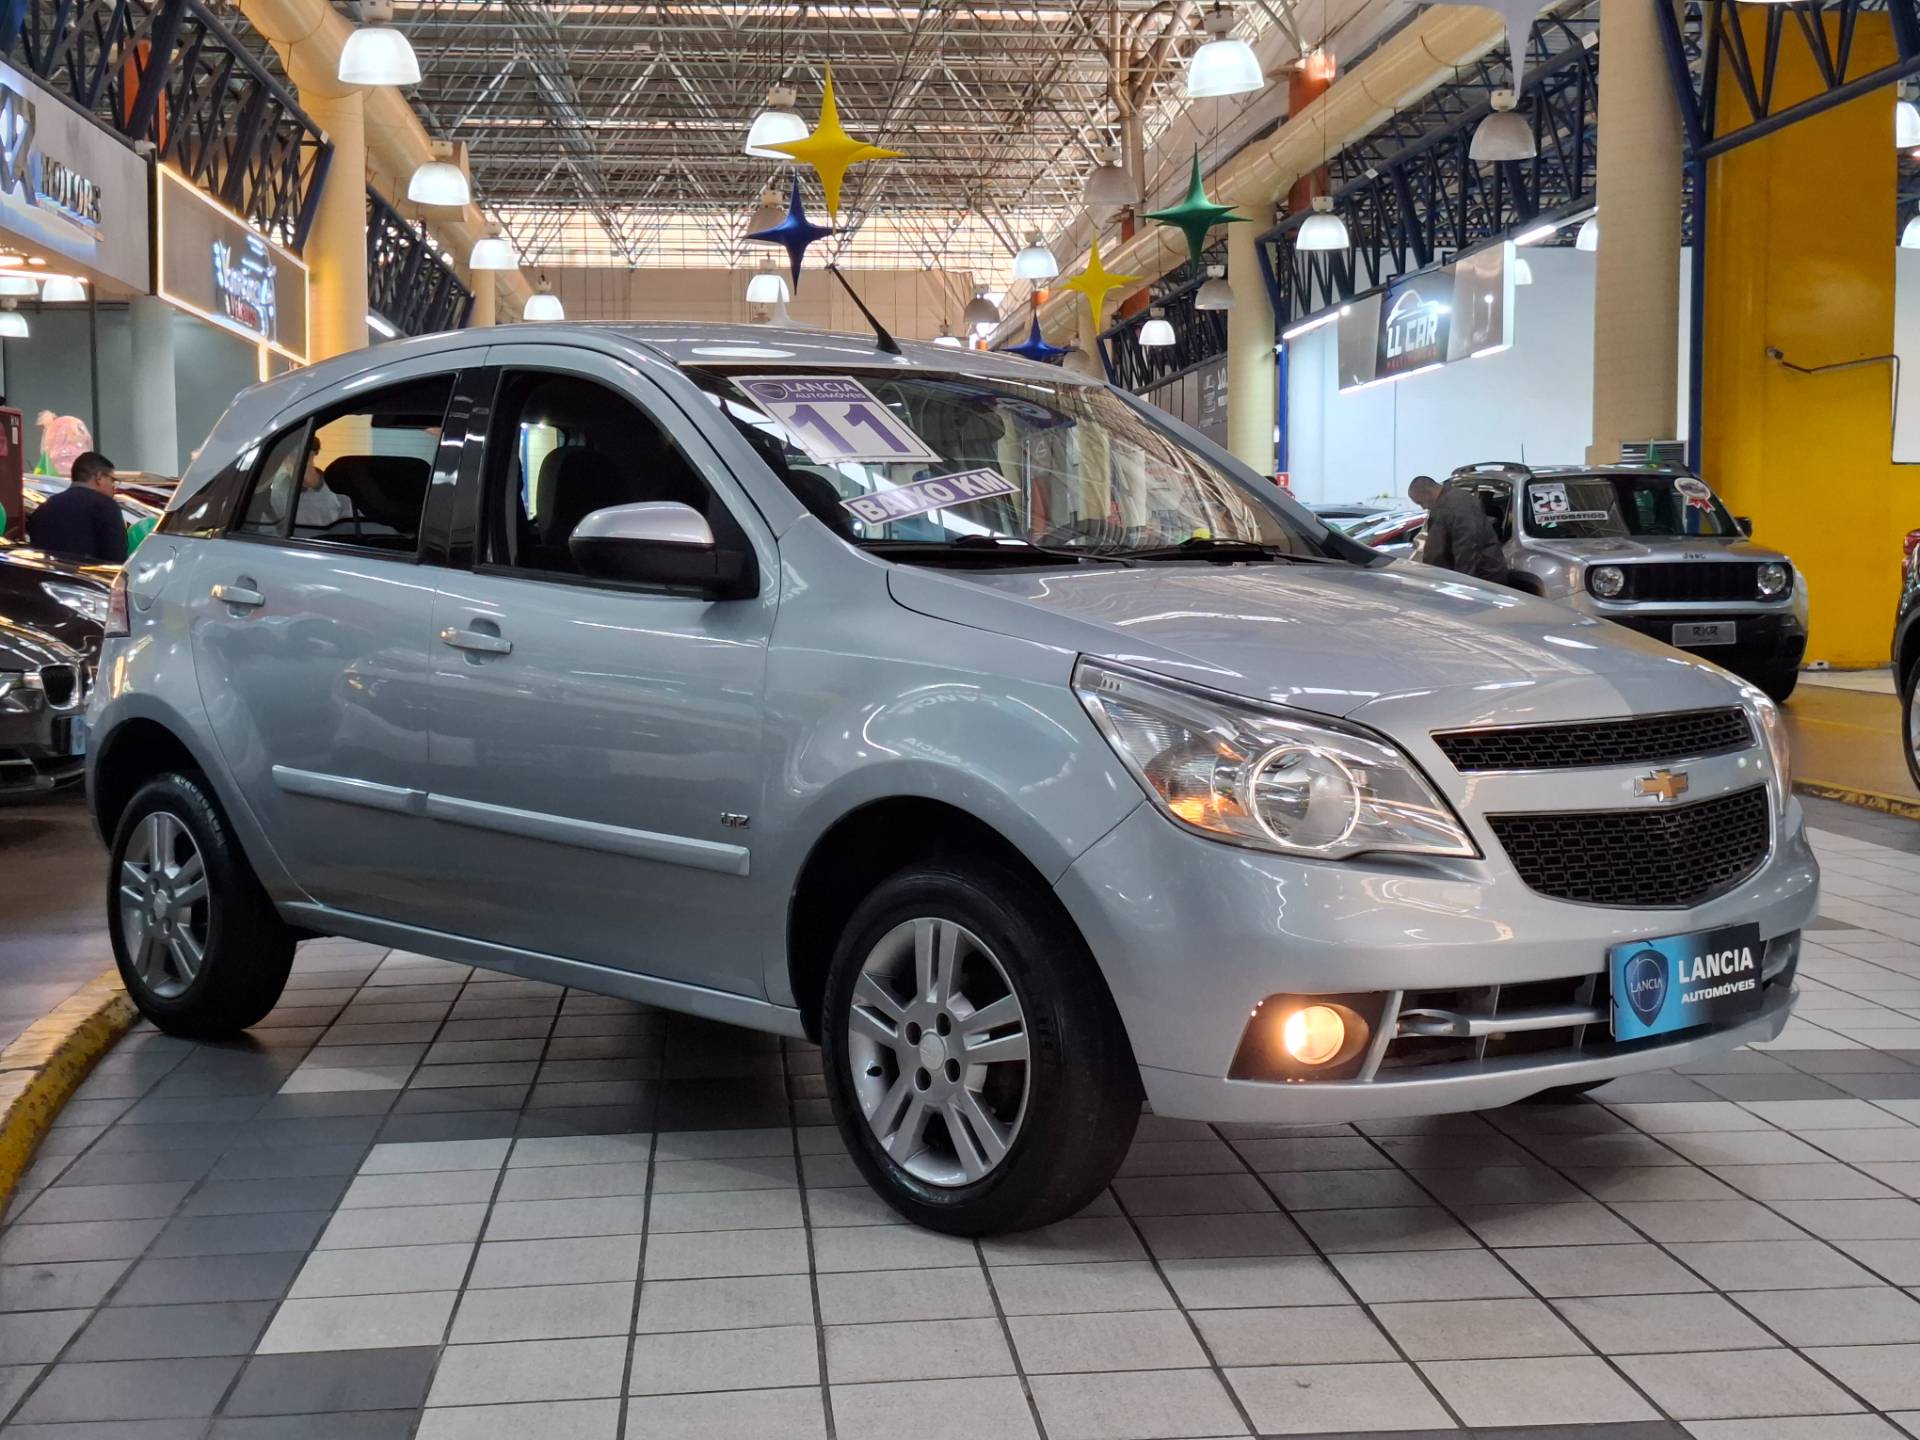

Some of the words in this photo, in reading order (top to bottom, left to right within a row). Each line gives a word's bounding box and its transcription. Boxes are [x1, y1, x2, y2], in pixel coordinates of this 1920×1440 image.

[1405, 312, 1438, 352] CAR
[781, 382, 859, 393] LANCIA
[788, 404, 911, 453] 11
[851, 482, 956, 520] BAIXO
[948, 471, 1009, 497] KM
[1679, 947, 1755, 984] LANCIA
[1630, 977, 1664, 993] LANCIA
[1681, 978, 1756, 1004] AUTOMÓVEIS
